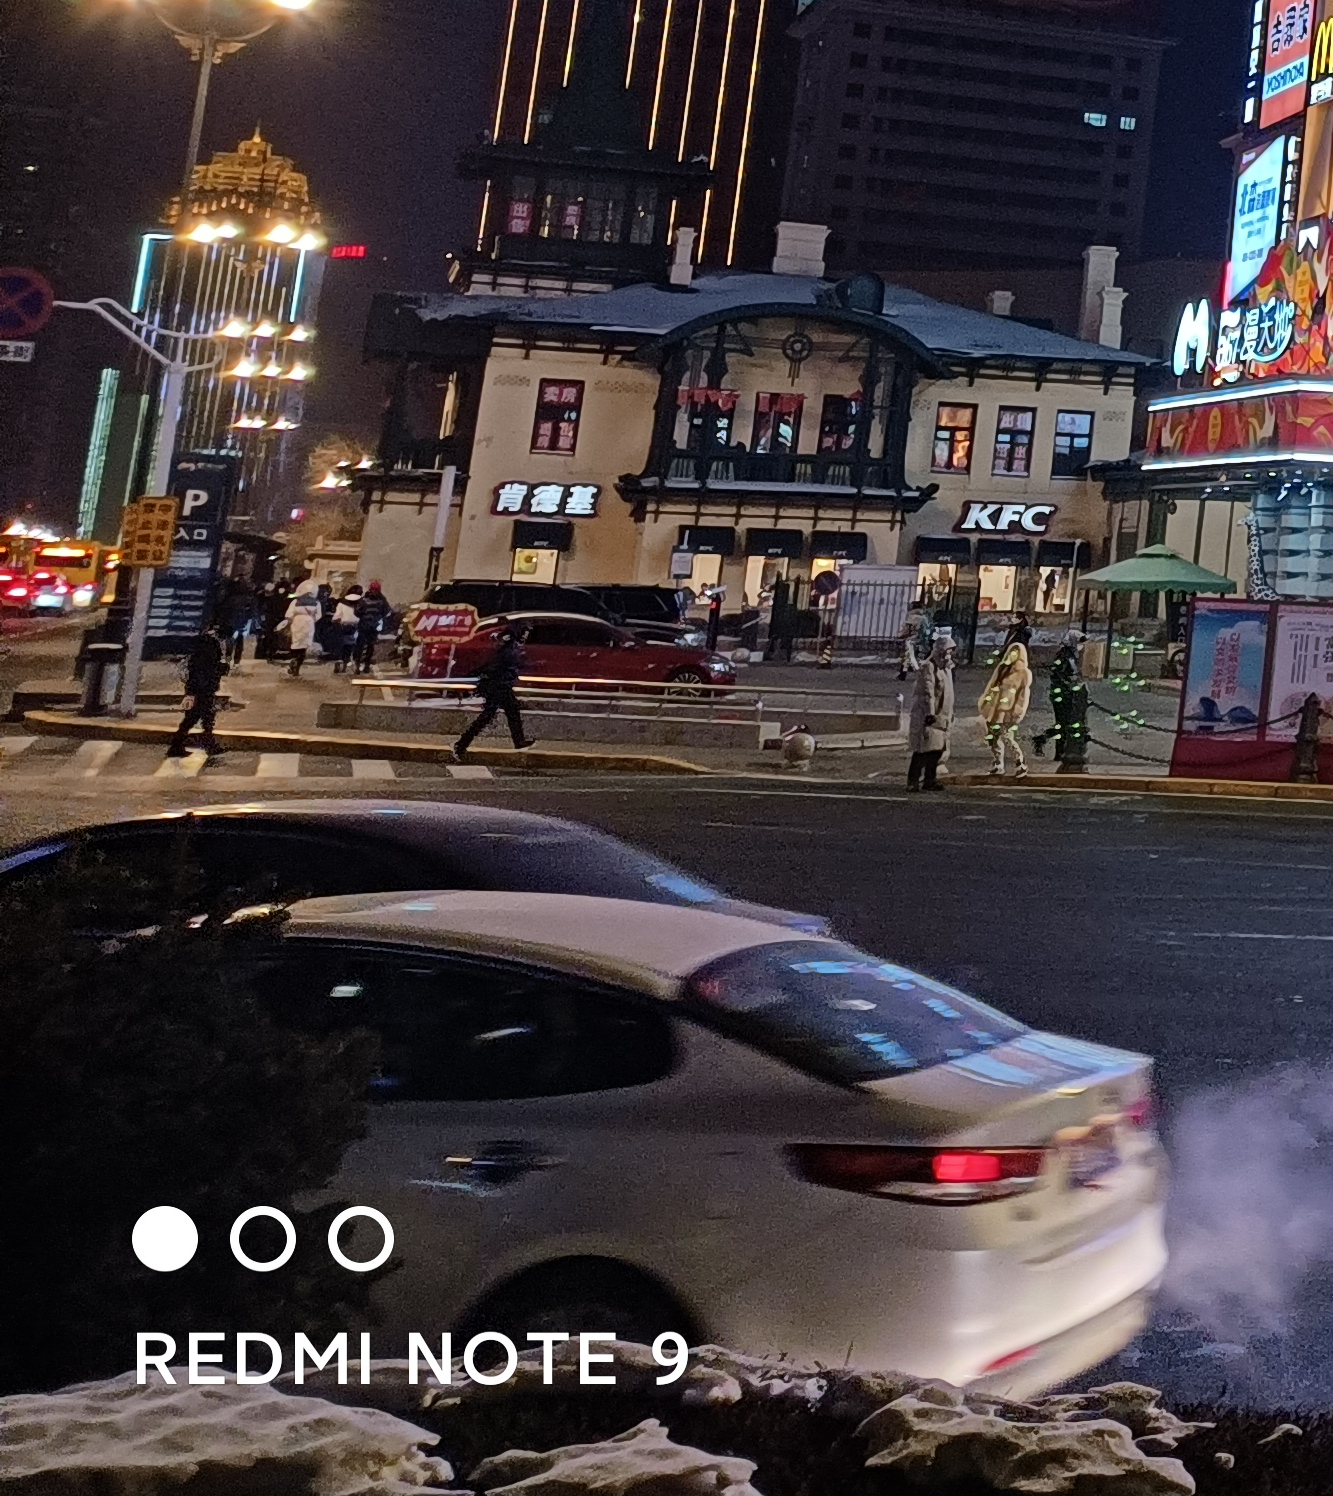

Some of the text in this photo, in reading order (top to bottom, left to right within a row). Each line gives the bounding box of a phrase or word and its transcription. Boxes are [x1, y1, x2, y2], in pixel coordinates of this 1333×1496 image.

[182, 489, 209, 517] P
[496, 483, 598, 514] 肯德基
[960, 503, 1056, 533] KFC
